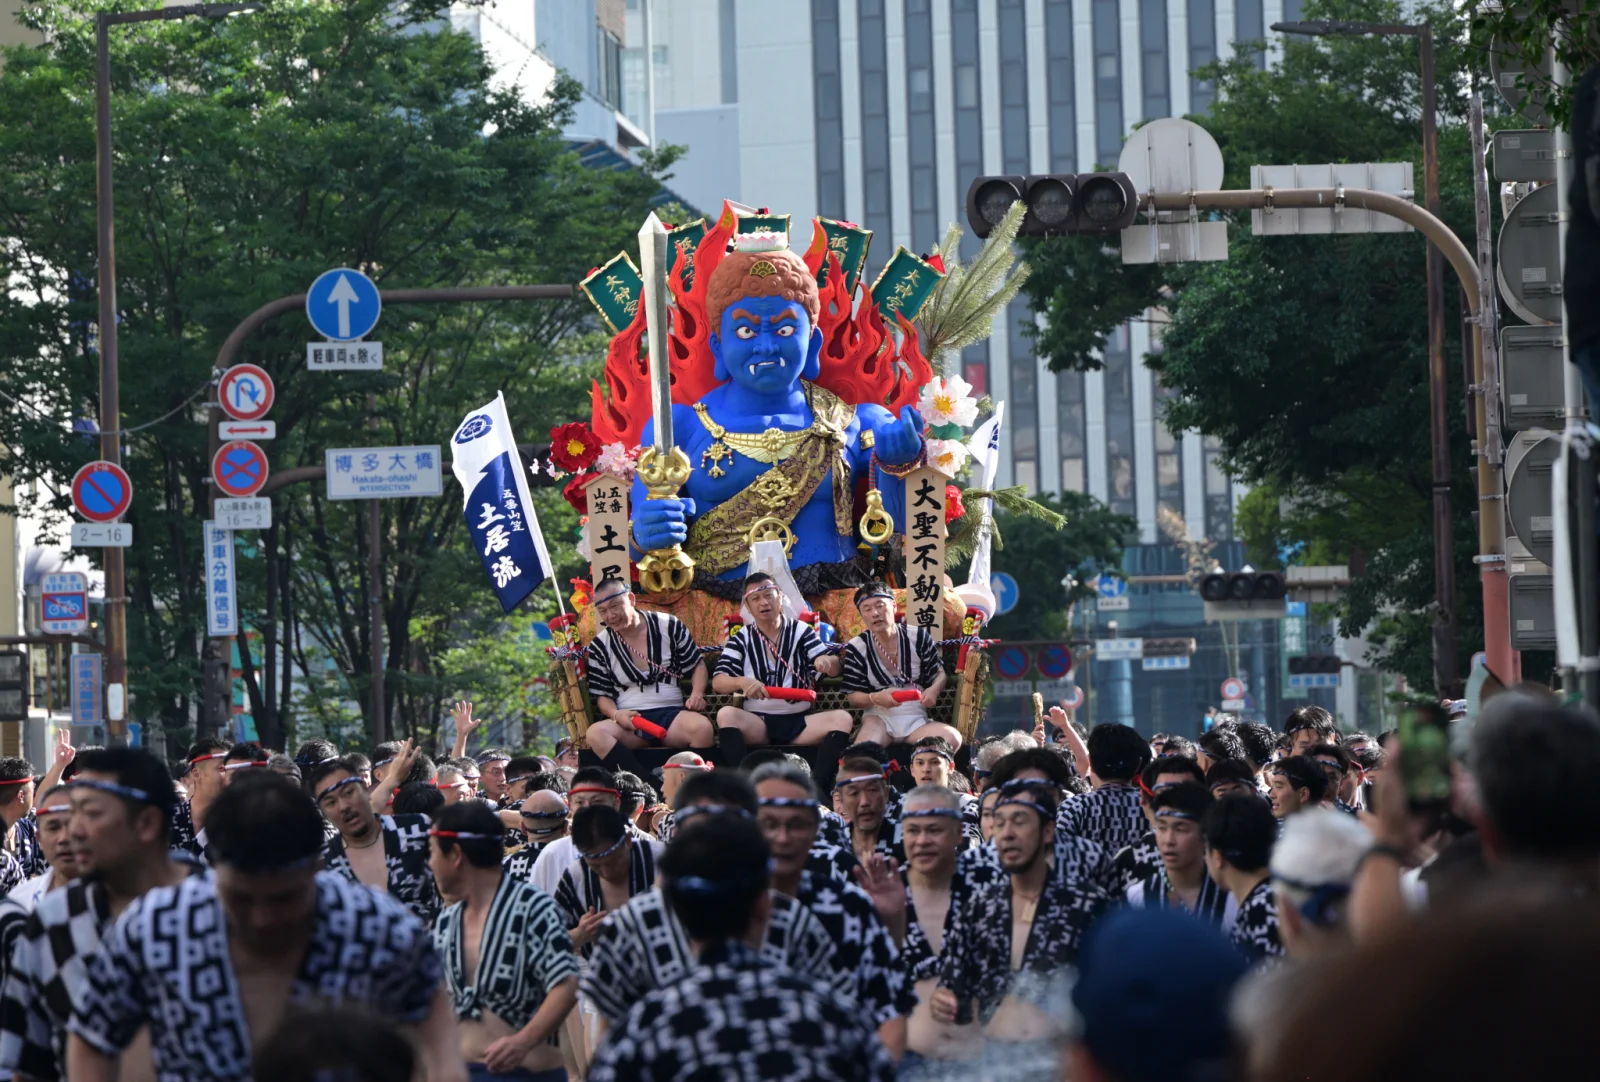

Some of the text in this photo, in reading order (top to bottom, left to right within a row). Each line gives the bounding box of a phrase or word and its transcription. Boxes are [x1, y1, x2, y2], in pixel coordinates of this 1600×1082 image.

[886, 268, 921, 311] 大神宮
[313, 348, 378, 364] 軽車両を除く
[334, 452, 433, 473] 博多大橋
[352, 473, 417, 484] Hakata-ohashi
[359, 484, 411, 492] INTERSECTION
[502, 489, 525, 532] 五番山笠
[477, 502, 522, 589] 土居流
[910, 478, 942, 634] 大聖不動尊
[211, 528, 230, 629] 歩車分離信号
